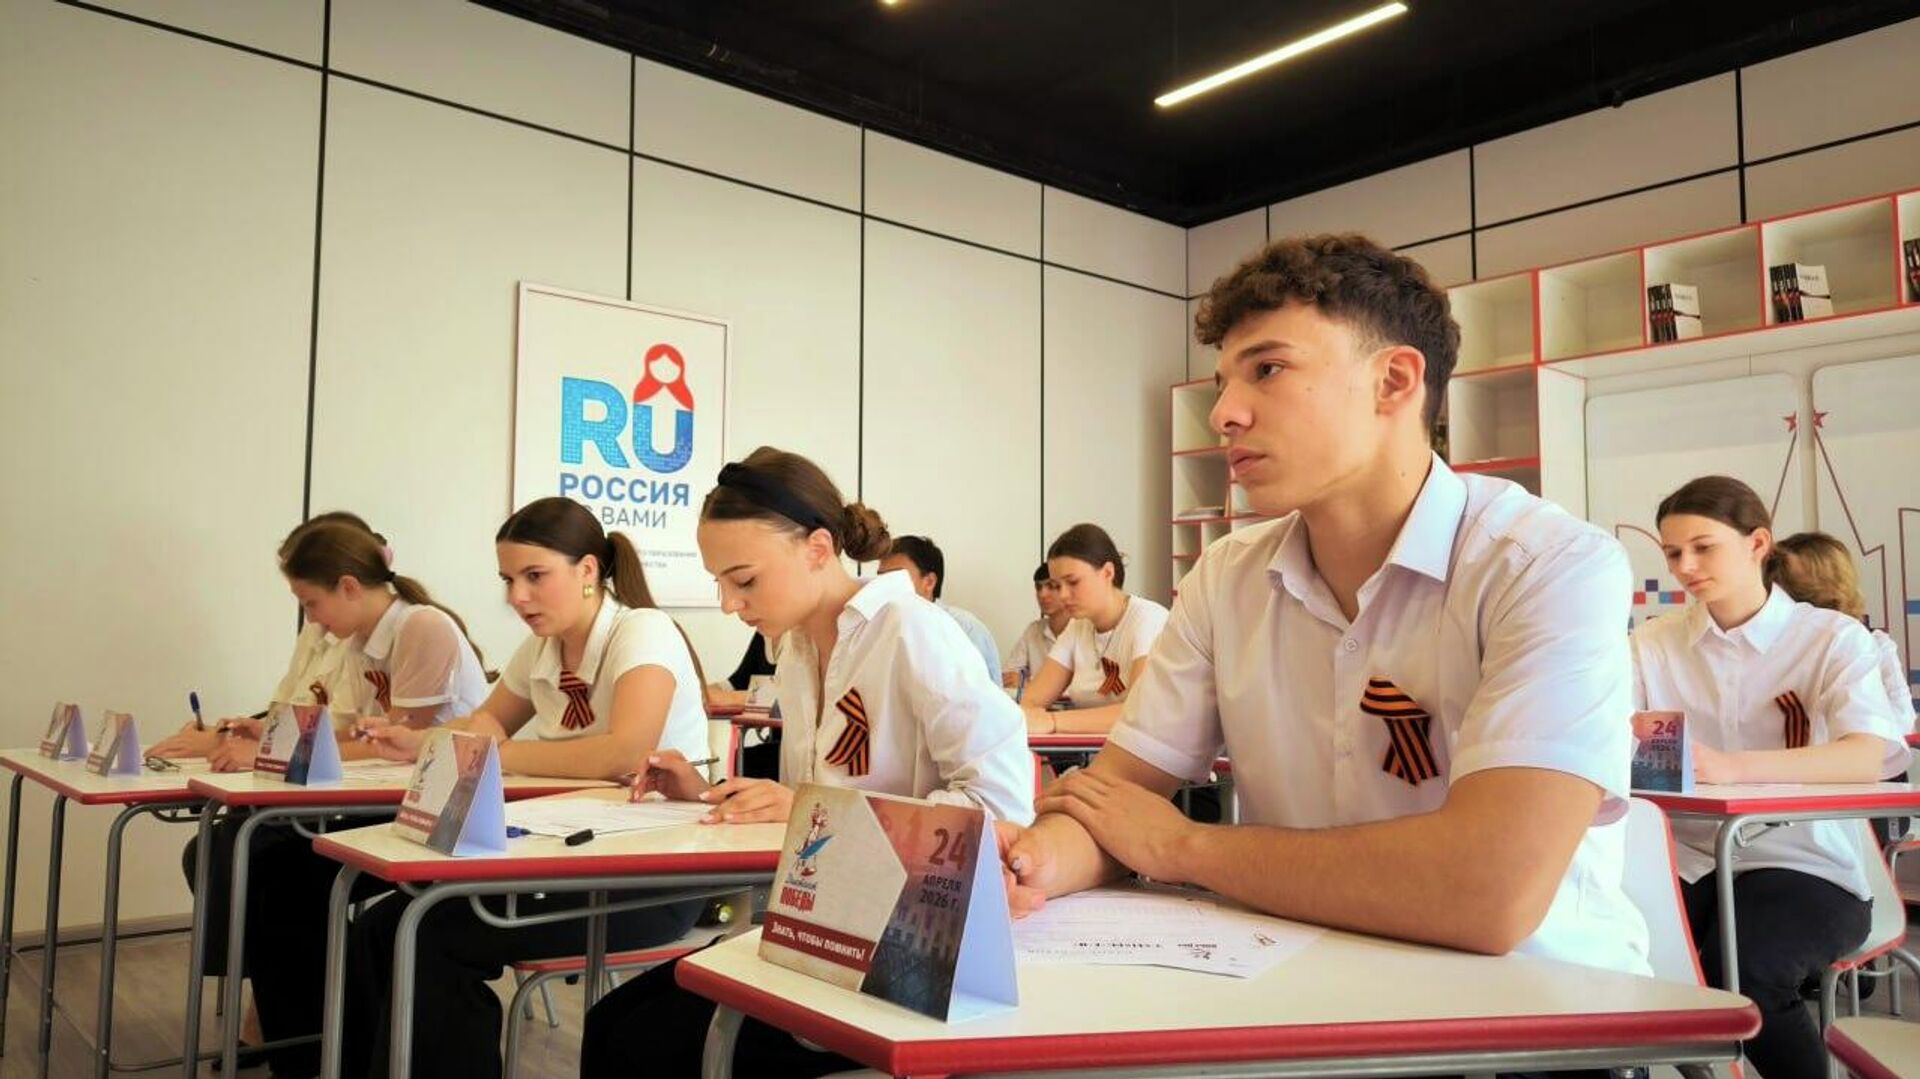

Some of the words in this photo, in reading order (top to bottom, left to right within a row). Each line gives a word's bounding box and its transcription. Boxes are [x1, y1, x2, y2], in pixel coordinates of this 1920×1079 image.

[562, 377, 693, 473] RU
[560, 473, 689, 506] РОССИЯ
[601, 506, 667, 529] ВАМИ
[1652, 720, 1677, 736] 24
[928, 828, 966, 870] 24
